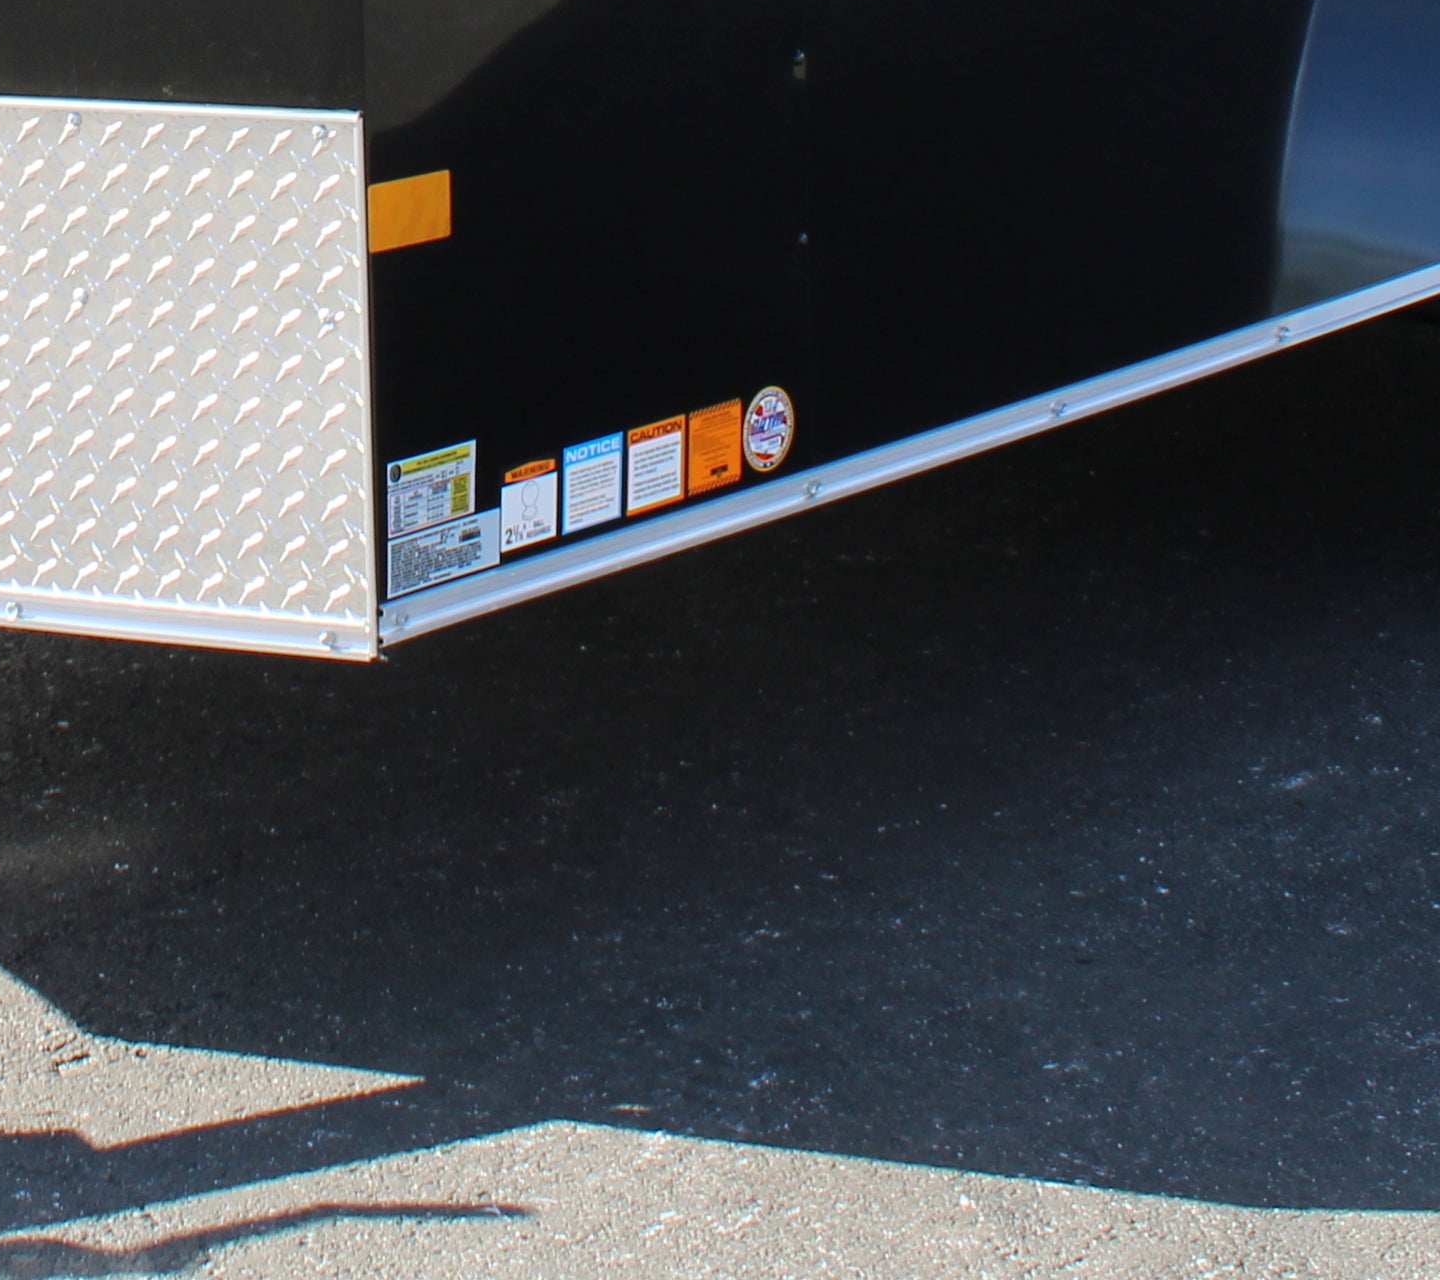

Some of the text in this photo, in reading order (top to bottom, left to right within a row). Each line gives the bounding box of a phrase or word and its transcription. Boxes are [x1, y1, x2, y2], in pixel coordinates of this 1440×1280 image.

[630, 420, 682, 444] CAUTION
[566, 436, 621, 463] NOTICE
[511, 460, 550, 479] WARNING
